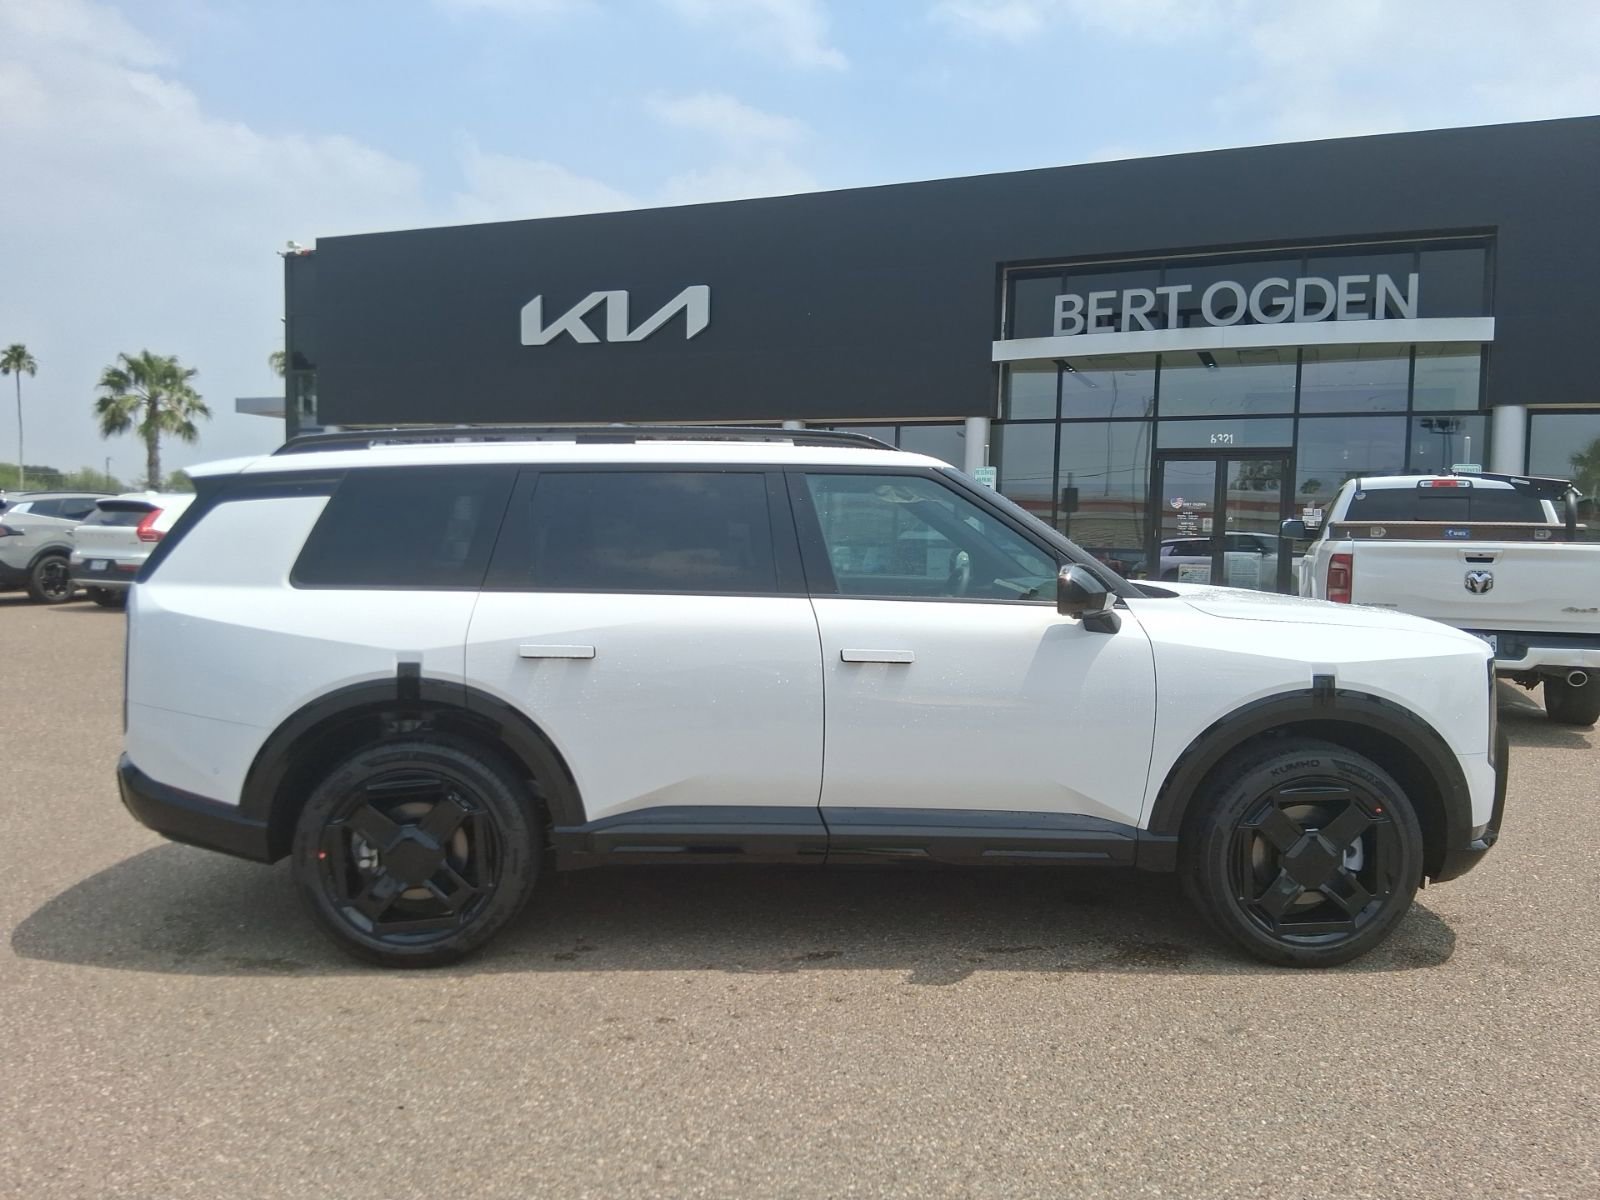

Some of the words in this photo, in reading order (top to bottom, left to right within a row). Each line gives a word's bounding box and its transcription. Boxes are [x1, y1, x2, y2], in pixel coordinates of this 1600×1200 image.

[521, 285, 710, 345] KIA
[1053, 284, 1193, 337] BERT
[1200, 273, 1419, 327] OGDEN
[1270, 759, 1320, 776] KUMHO
